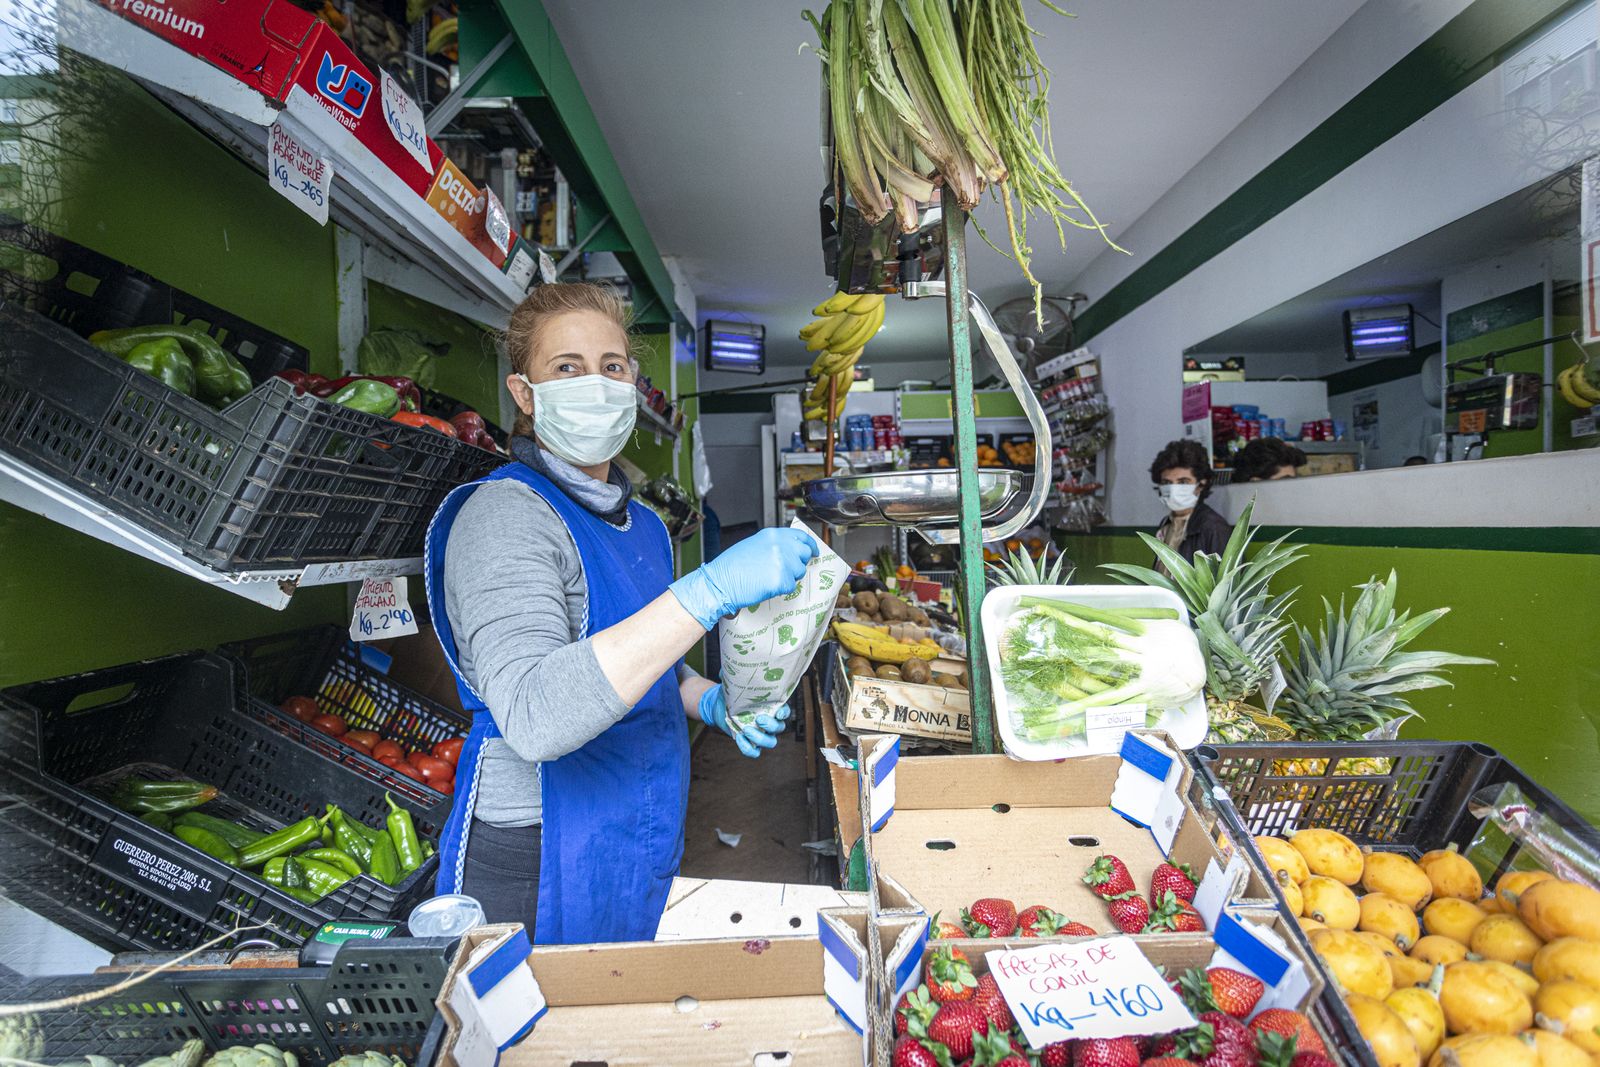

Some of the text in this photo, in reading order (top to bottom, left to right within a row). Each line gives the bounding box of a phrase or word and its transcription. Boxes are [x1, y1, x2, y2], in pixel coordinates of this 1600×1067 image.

[273, 140, 294, 167] ASAR
[315, 159, 326, 175] DE
[438, 168, 476, 216] DELTA
[893, 704, 951, 728] MONNA
[113, 838, 157, 865] GUERRERO
[155, 857, 182, 877] PEREZ
[180, 869, 198, 888] 2005,
[127, 857, 150, 871] MEDINA
[149, 866, 171, 881] SIDONIA
[149, 874, 159, 882] 956
[997, 943, 1116, 979] FRESAS DE
